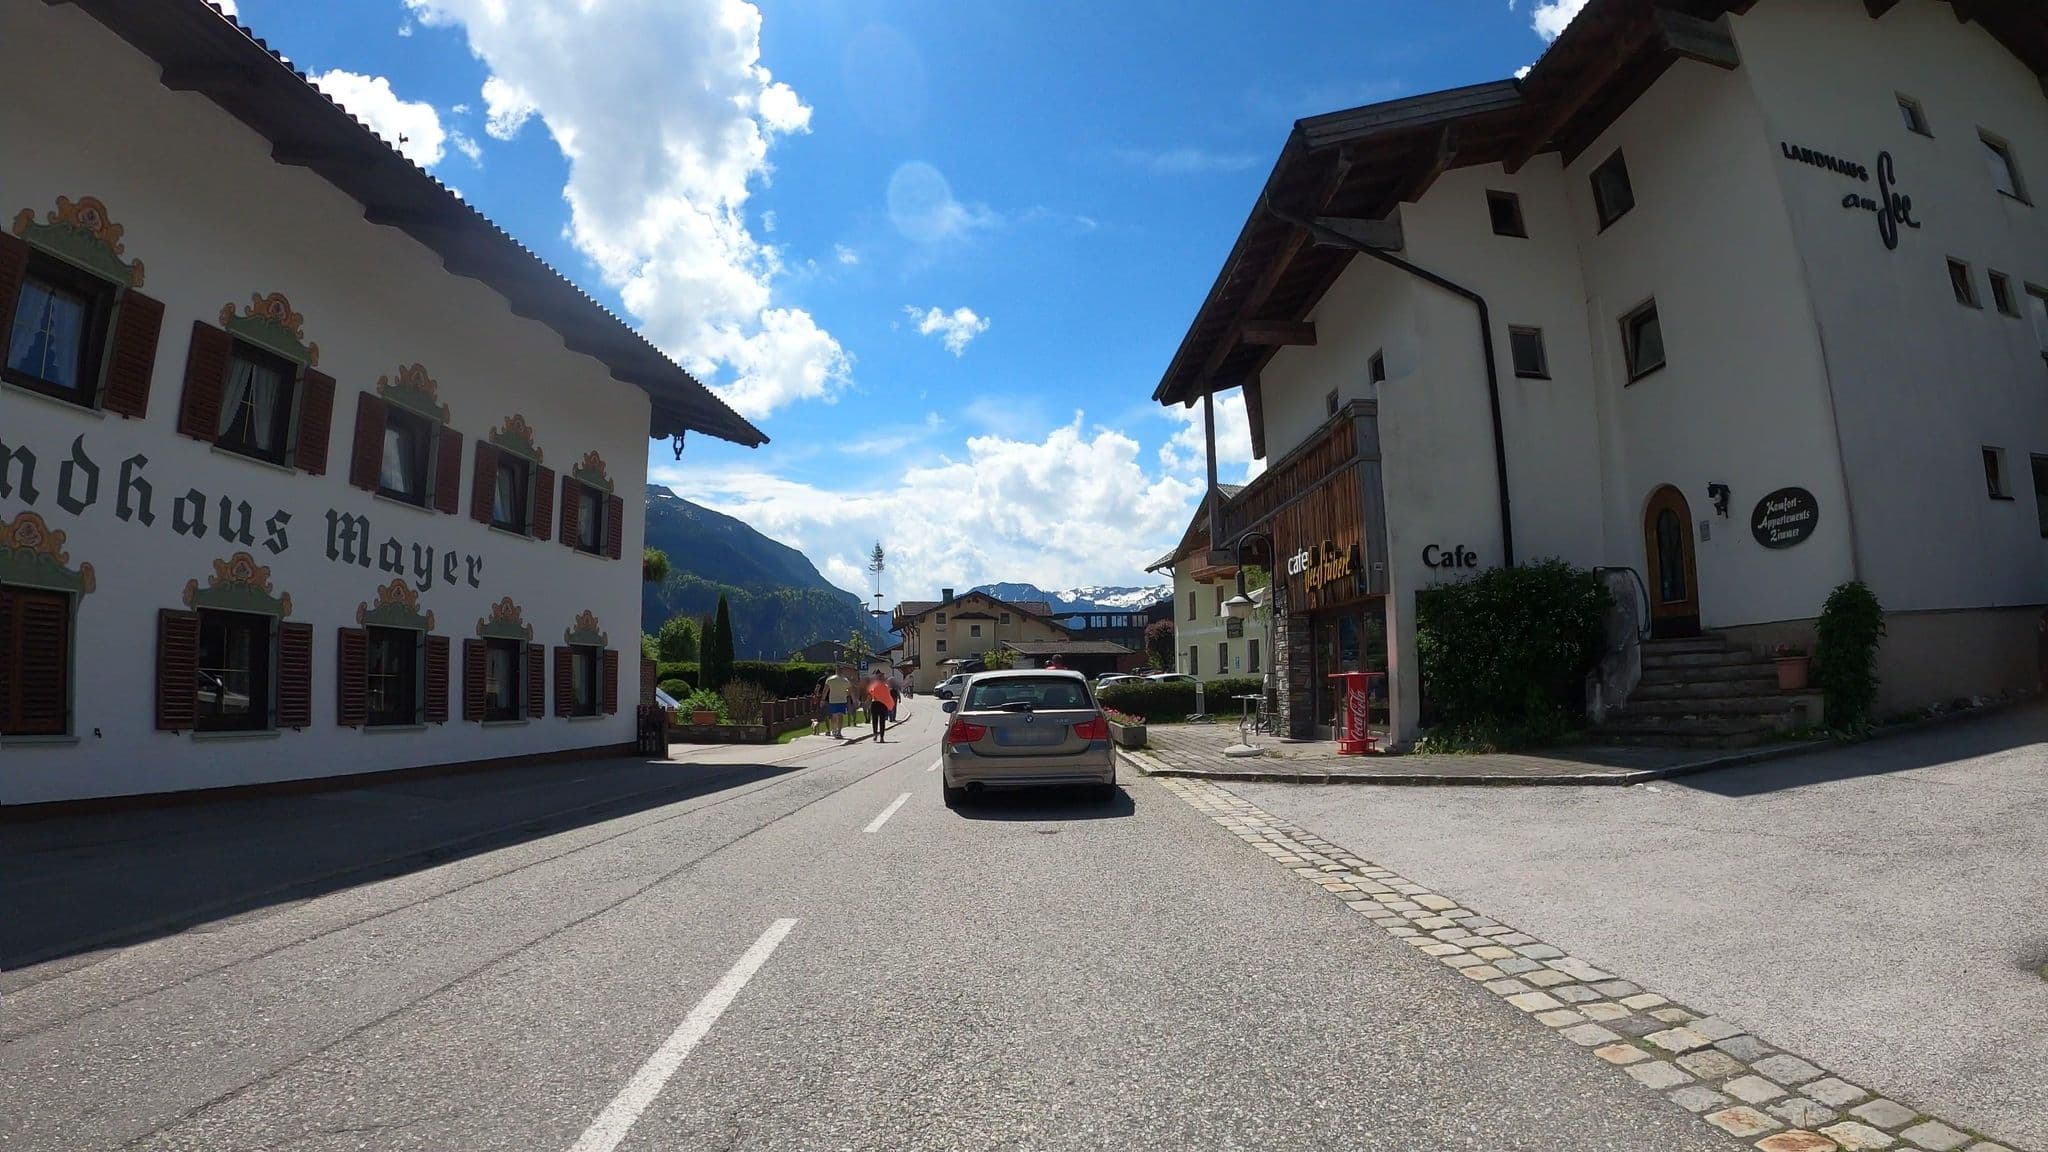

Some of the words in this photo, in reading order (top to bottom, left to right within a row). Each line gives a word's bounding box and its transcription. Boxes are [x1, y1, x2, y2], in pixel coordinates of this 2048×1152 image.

[1781, 141, 1869, 182] LANDHAUS
[1841, 193, 1878, 212] am
[1770, 528, 1800, 542] Zimmer
[325, 507, 483, 593] Mayer
[1422, 544, 1478, 568] Cafe
